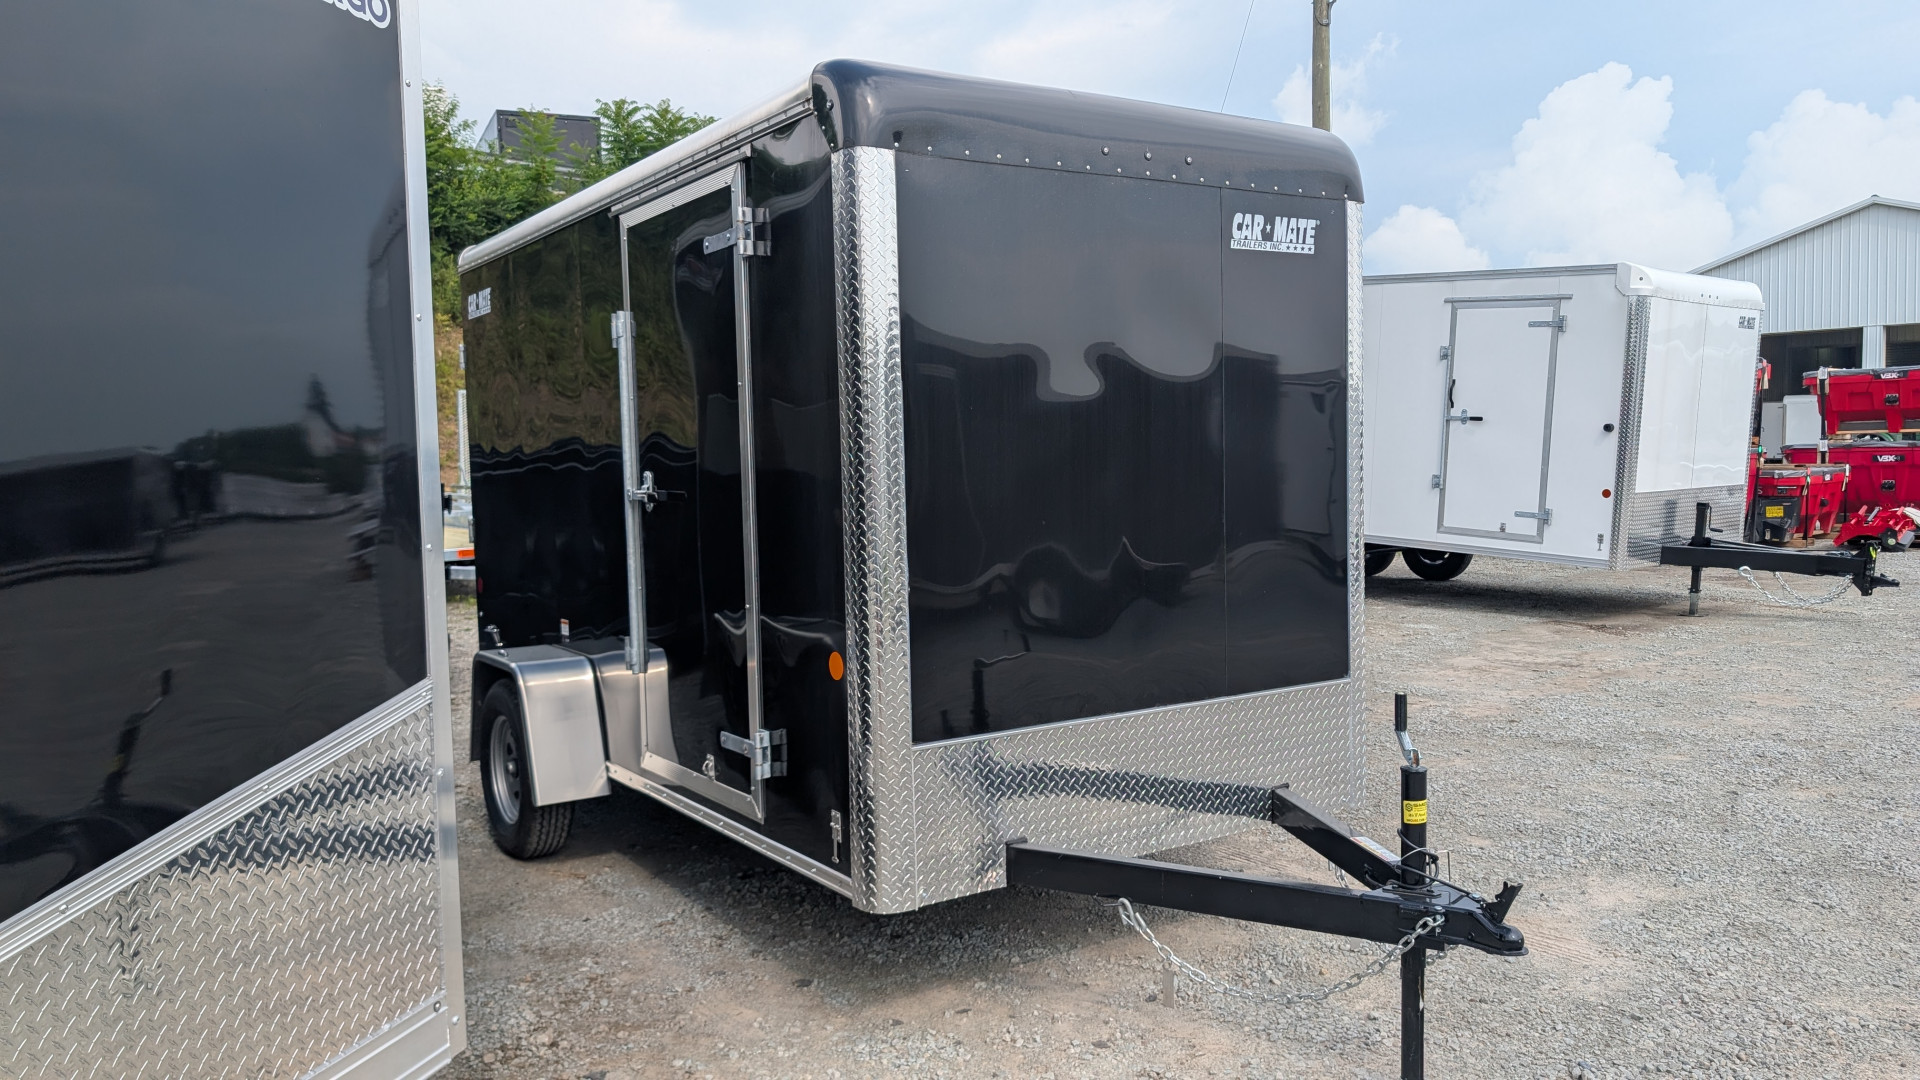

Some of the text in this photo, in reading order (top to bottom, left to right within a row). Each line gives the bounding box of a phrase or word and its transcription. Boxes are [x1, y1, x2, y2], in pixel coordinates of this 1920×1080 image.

[1232, 212, 1265, 241] CAR
[1232, 240, 1284, 252] TRAILERS INC.
